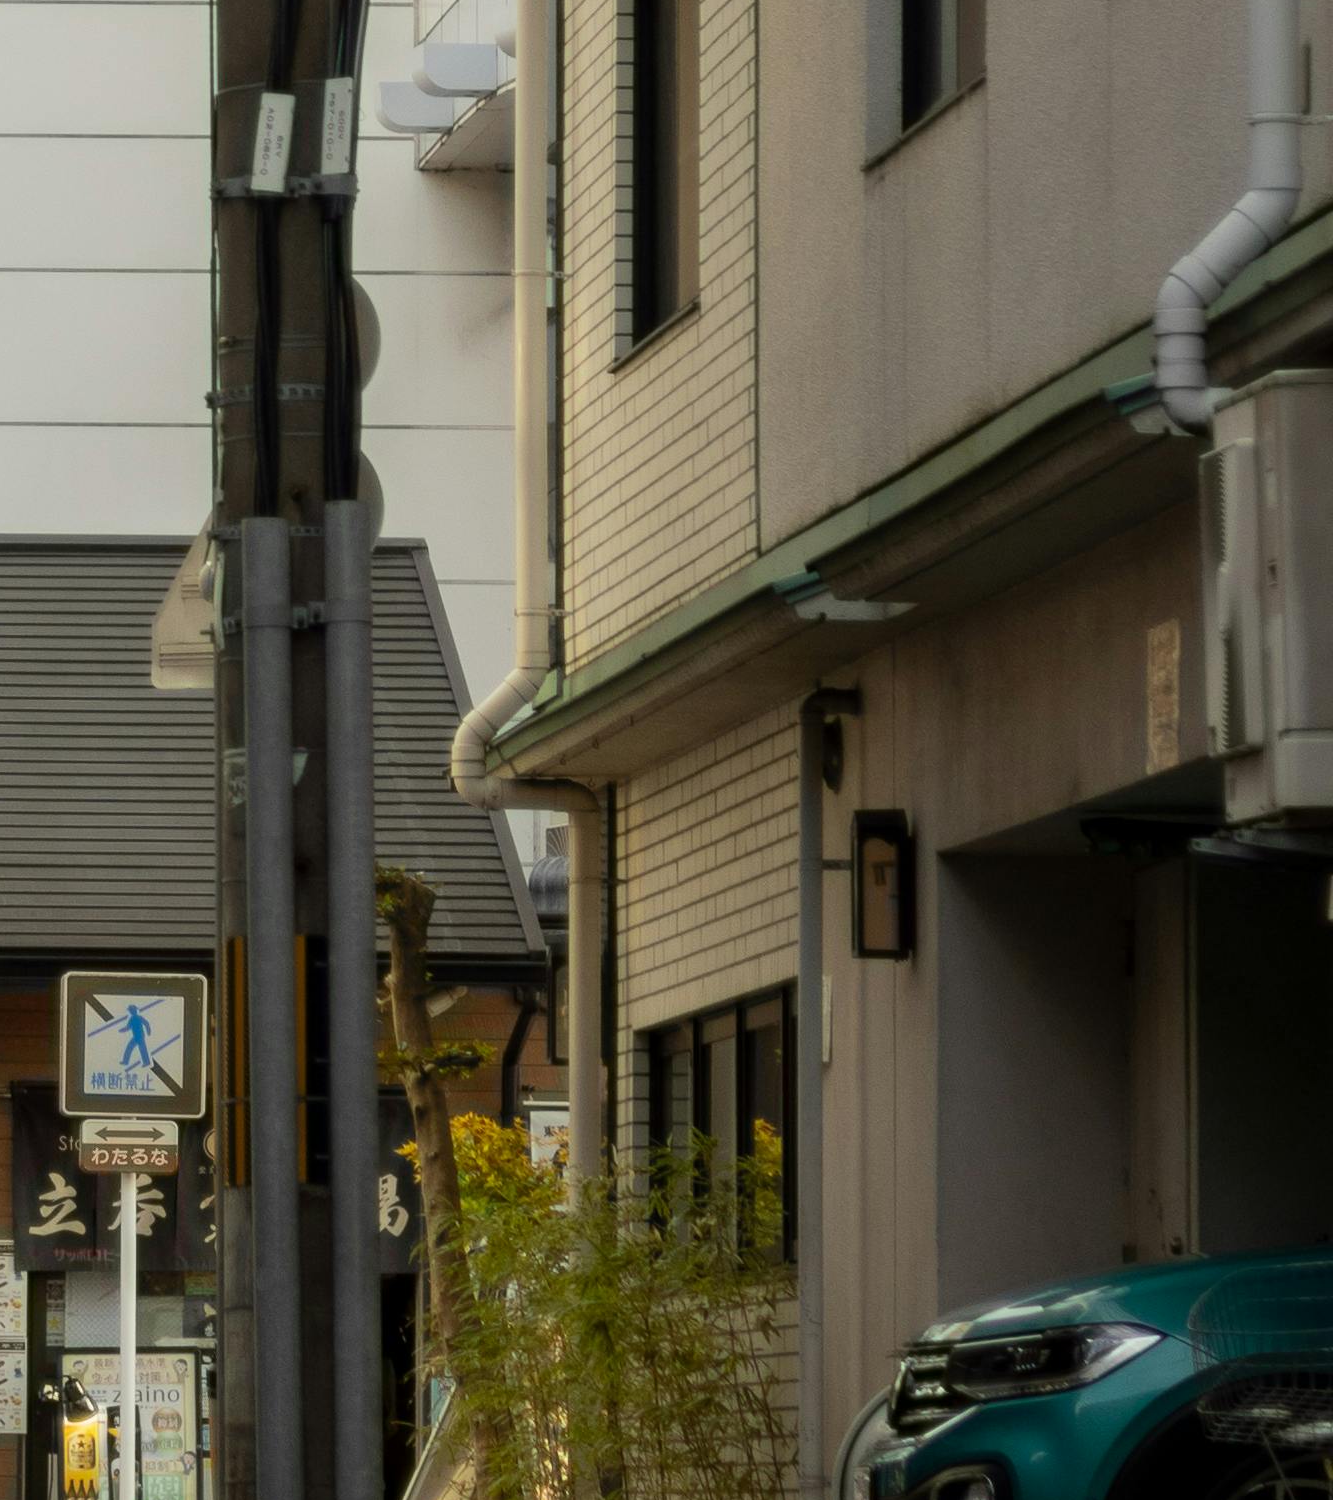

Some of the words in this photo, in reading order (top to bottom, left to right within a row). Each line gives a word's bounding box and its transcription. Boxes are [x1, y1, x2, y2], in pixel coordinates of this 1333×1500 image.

[91, 1071, 156, 1092] 横断禁止
[91, 1148, 169, 1166] わたるな
[113, 1385, 181, 1404] zaino
